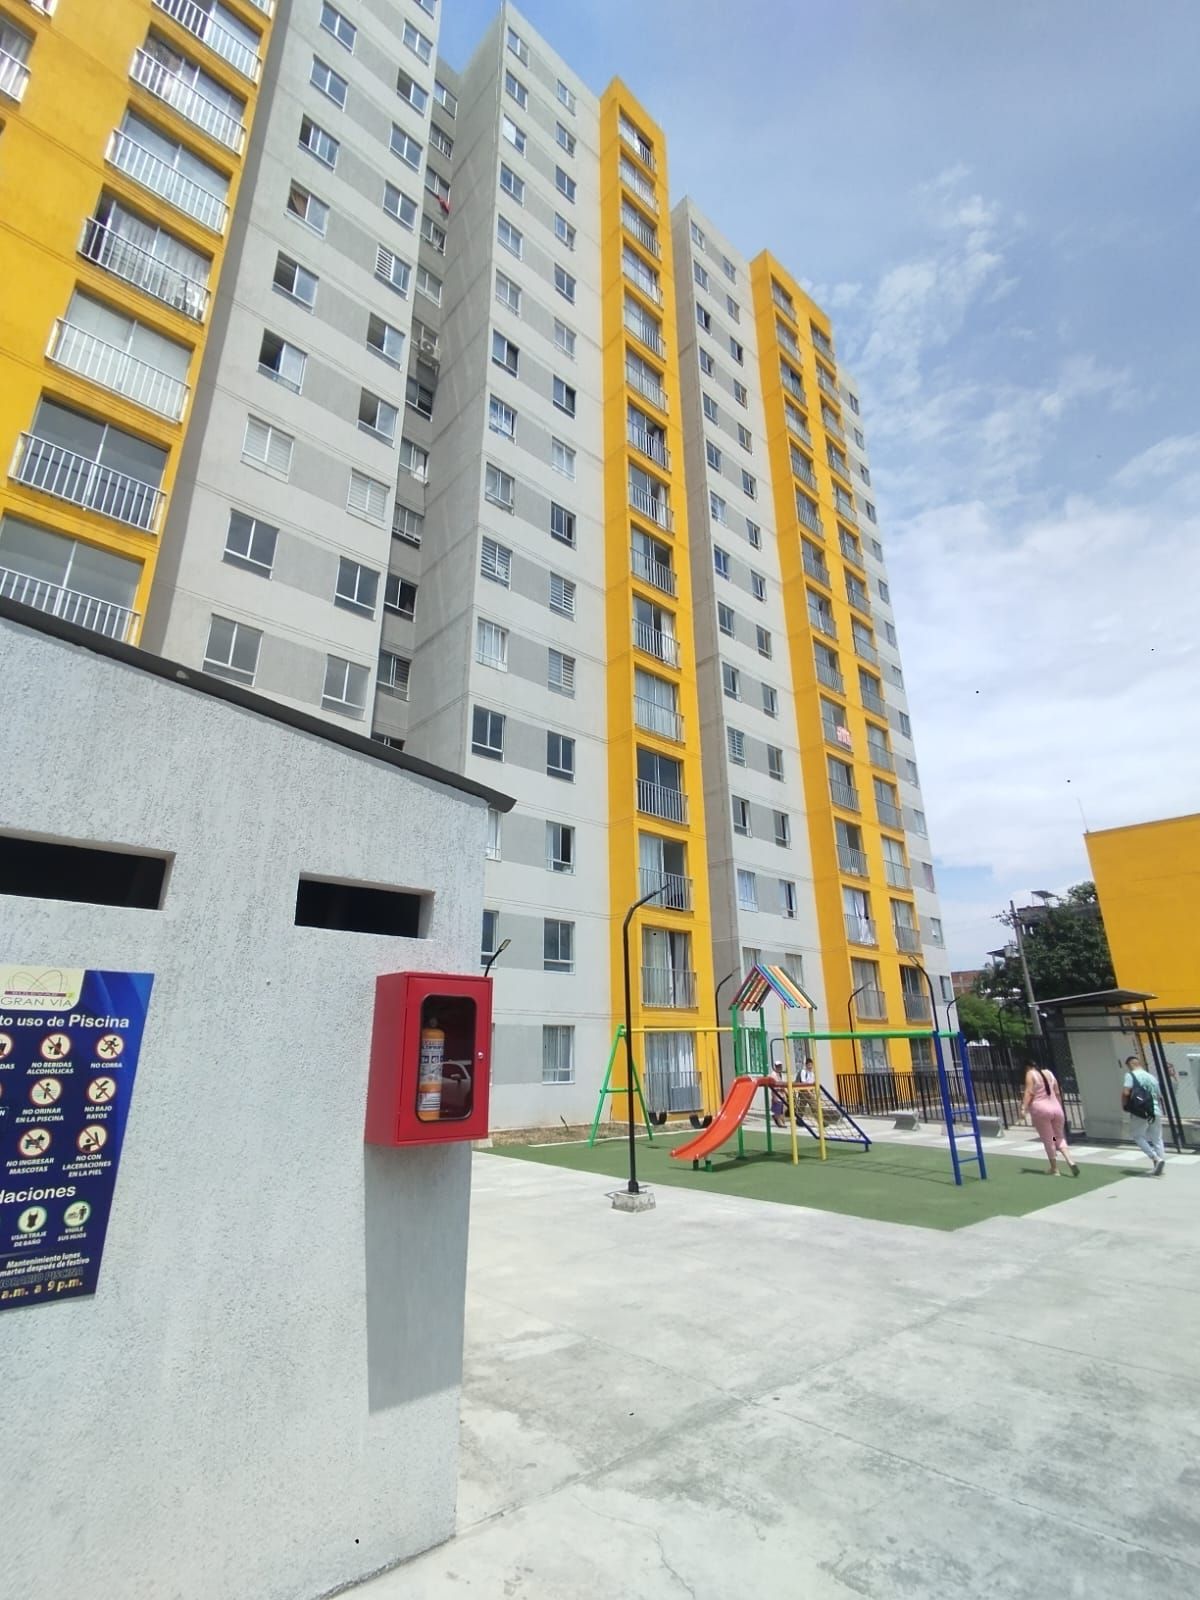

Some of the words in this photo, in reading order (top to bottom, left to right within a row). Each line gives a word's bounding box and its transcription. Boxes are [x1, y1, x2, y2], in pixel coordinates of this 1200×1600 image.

[1, 996, 45, 1006] GRAN
[17, 1017, 43, 1026] uso
[47, 1015, 65, 1027] de
[68, 1014, 130, 1028] Piscina
[37, 1114, 64, 1122] PISCINA
[18, 1158, 54, 1166] INGRESAR
[62, 1160, 112, 1171] LACERACIONES
[9, 1166, 48, 1175] MASCOTAS
[11, 1232, 28, 1241] USAR
[28, 1230, 47, 1239] TRAJE
[0, 1267, 26, 1277] martes
[26, 1262, 56, 1272] después
[56, 1260, 66, 1268] de
[66, 1257, 90, 1266] festivo
[6, 1255, 61, 1268] Mantenimiento
[1, 1288, 29, 1299] a.m.
[34, 1284, 42, 1294] a
[47, 1280, 55, 1291] 9
[56, 1278, 83, 1292] p.m.
